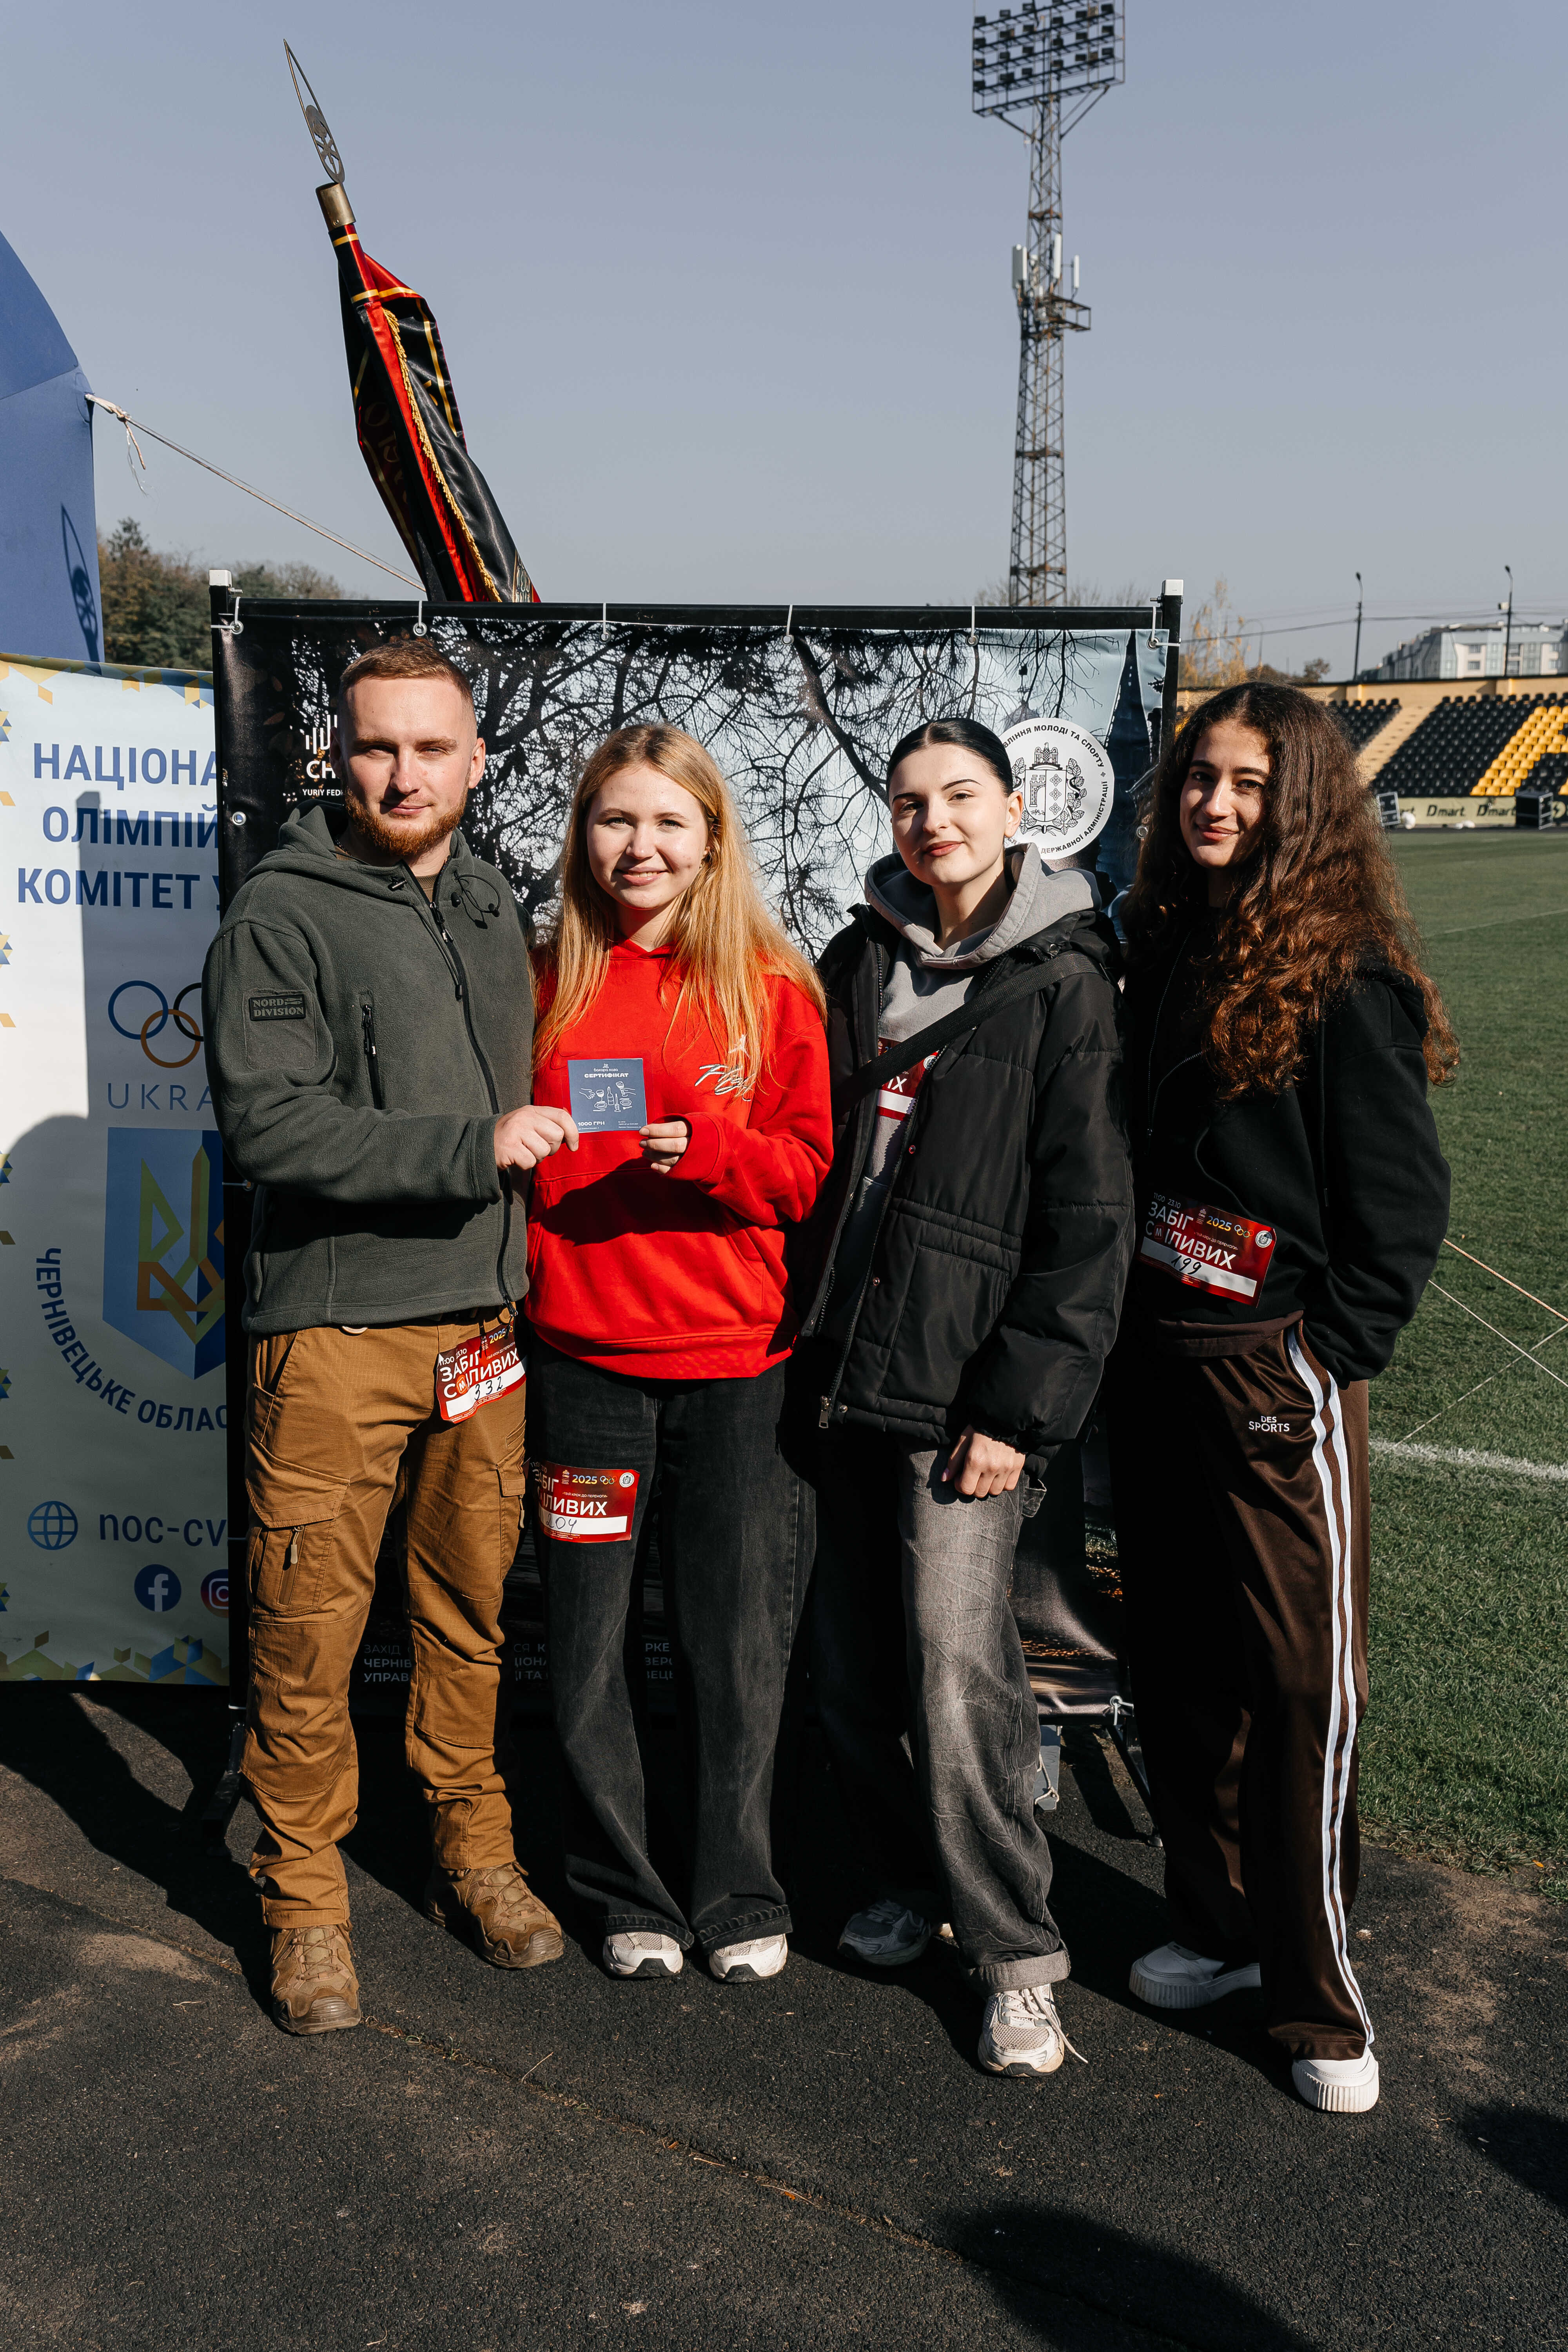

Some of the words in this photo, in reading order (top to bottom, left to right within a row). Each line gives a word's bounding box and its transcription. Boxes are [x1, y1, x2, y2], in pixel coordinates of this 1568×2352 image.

[1034, 725, 1067, 735] МОЛОДІ
[1071, 731, 1080, 740] ТА
[1081, 739, 1104, 768] СПОРТУ
[42, 804, 218, 849] ОЛІМПІЙ
[1041, 834, 1083, 854] ДЕРЖАВНОЇ
[1084, 781, 1108, 837] АДМІНІСТРАЦІЇ
[18, 867, 200, 909] КОМІТЕТ
[253, 998, 284, 1007] NORD
[1167, 1199, 1181, 1209] 23.10
[1148, 1201, 1194, 1230] ЗАБІГ
[1206, 1216, 1232, 1231] 2025
[1171, 1255, 1201, 1274] 199
[36, 1247, 136, 1414] ЧЕРНІВЕЦЬКЕ
[489, 1328, 506, 1344] 2025
[439, 1357, 454, 1366] 11:00
[456, 1348, 467, 1359] 23.10
[440, 1350, 480, 1382] ЗАБІГ
[474, 1376, 503, 1401] 332
[1249, 1421, 1290, 1432] SPORTS
[572, 1474, 597, 1484] 2025
[546, 1514, 577, 1533] 204
[364, 1644, 401, 1656] ЗАХІД
[525, 1670, 542, 1680] ТА
